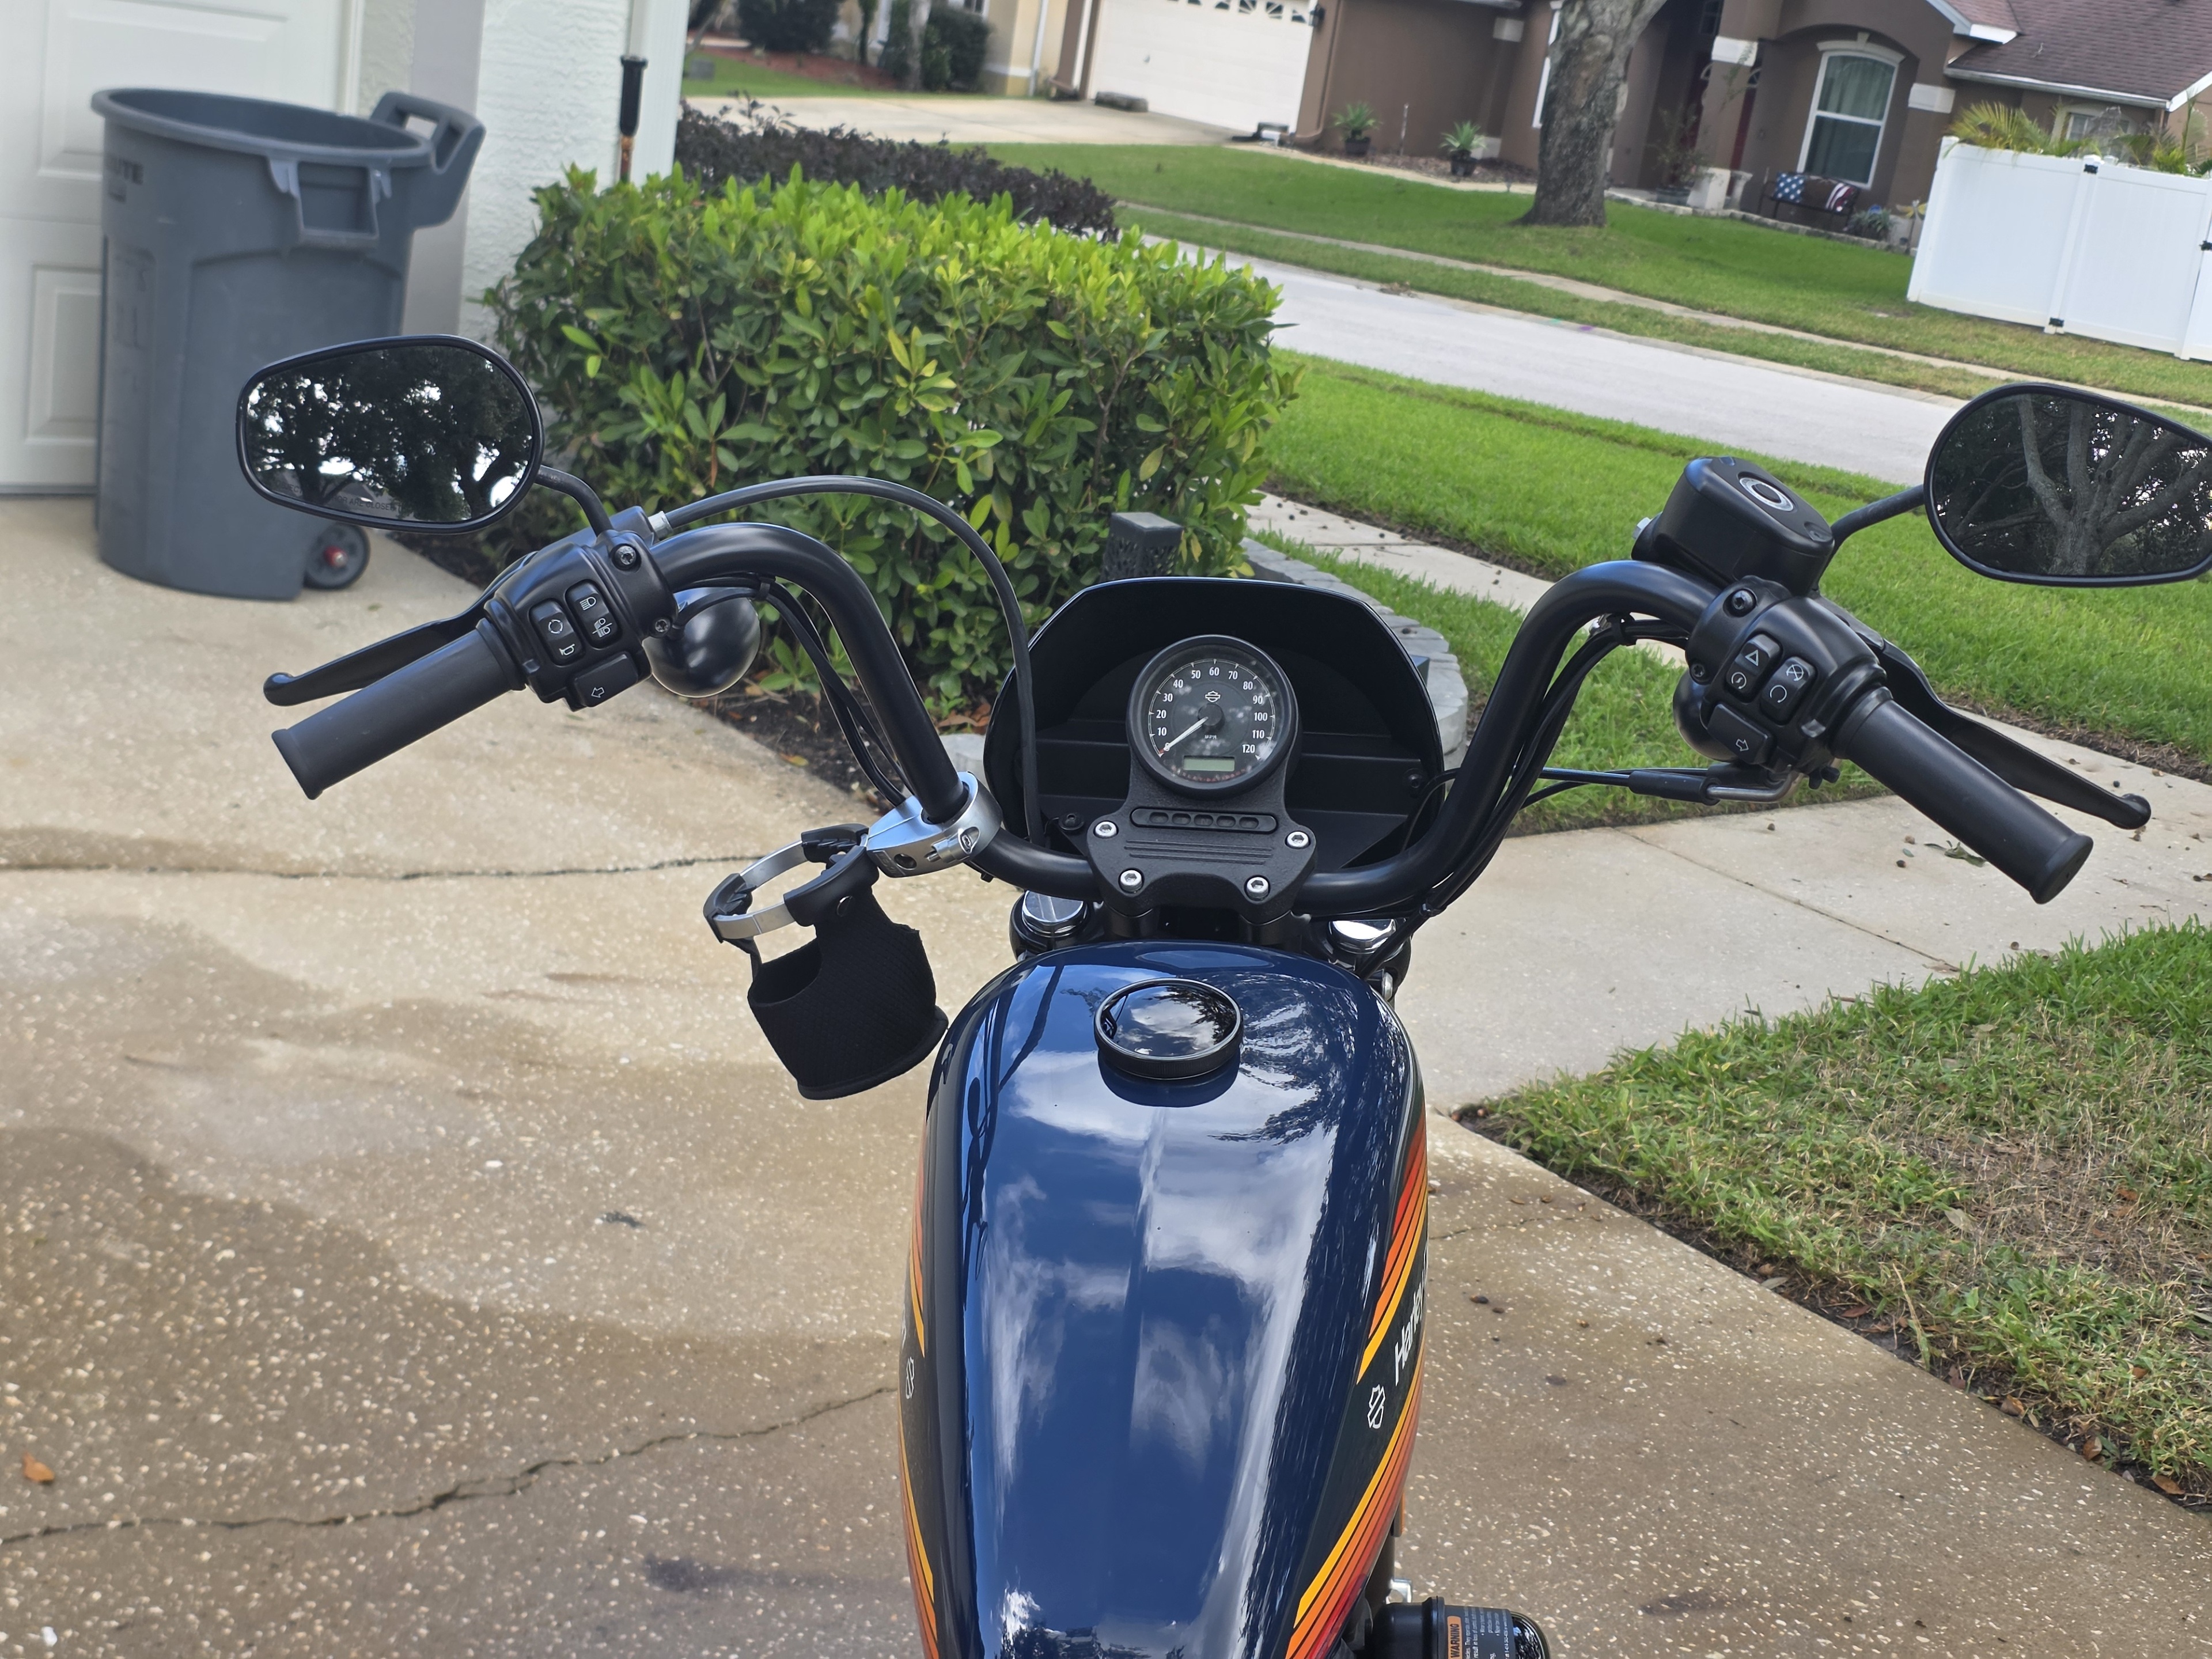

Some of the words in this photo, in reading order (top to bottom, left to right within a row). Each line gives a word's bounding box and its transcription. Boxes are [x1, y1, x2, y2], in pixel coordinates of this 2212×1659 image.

[1191, 670, 1201, 679] 50
[1209, 667, 1219, 676] 60
[1228, 671, 1238, 680] 70
[1173, 679, 1183, 688] 40
[1243, 681, 1253, 690] 80
[1162, 693, 1173, 702] 30
[1253, 695, 1263, 704] 90
[1156, 710, 1166, 719] 20
[1254, 712, 1268, 721] 100
[1157, 727, 1167, 736] 10
[1252, 730, 1264, 739] 110
[1243, 744, 1255, 753] 120
[1450, 1623, 1460, 1658] WARNING
